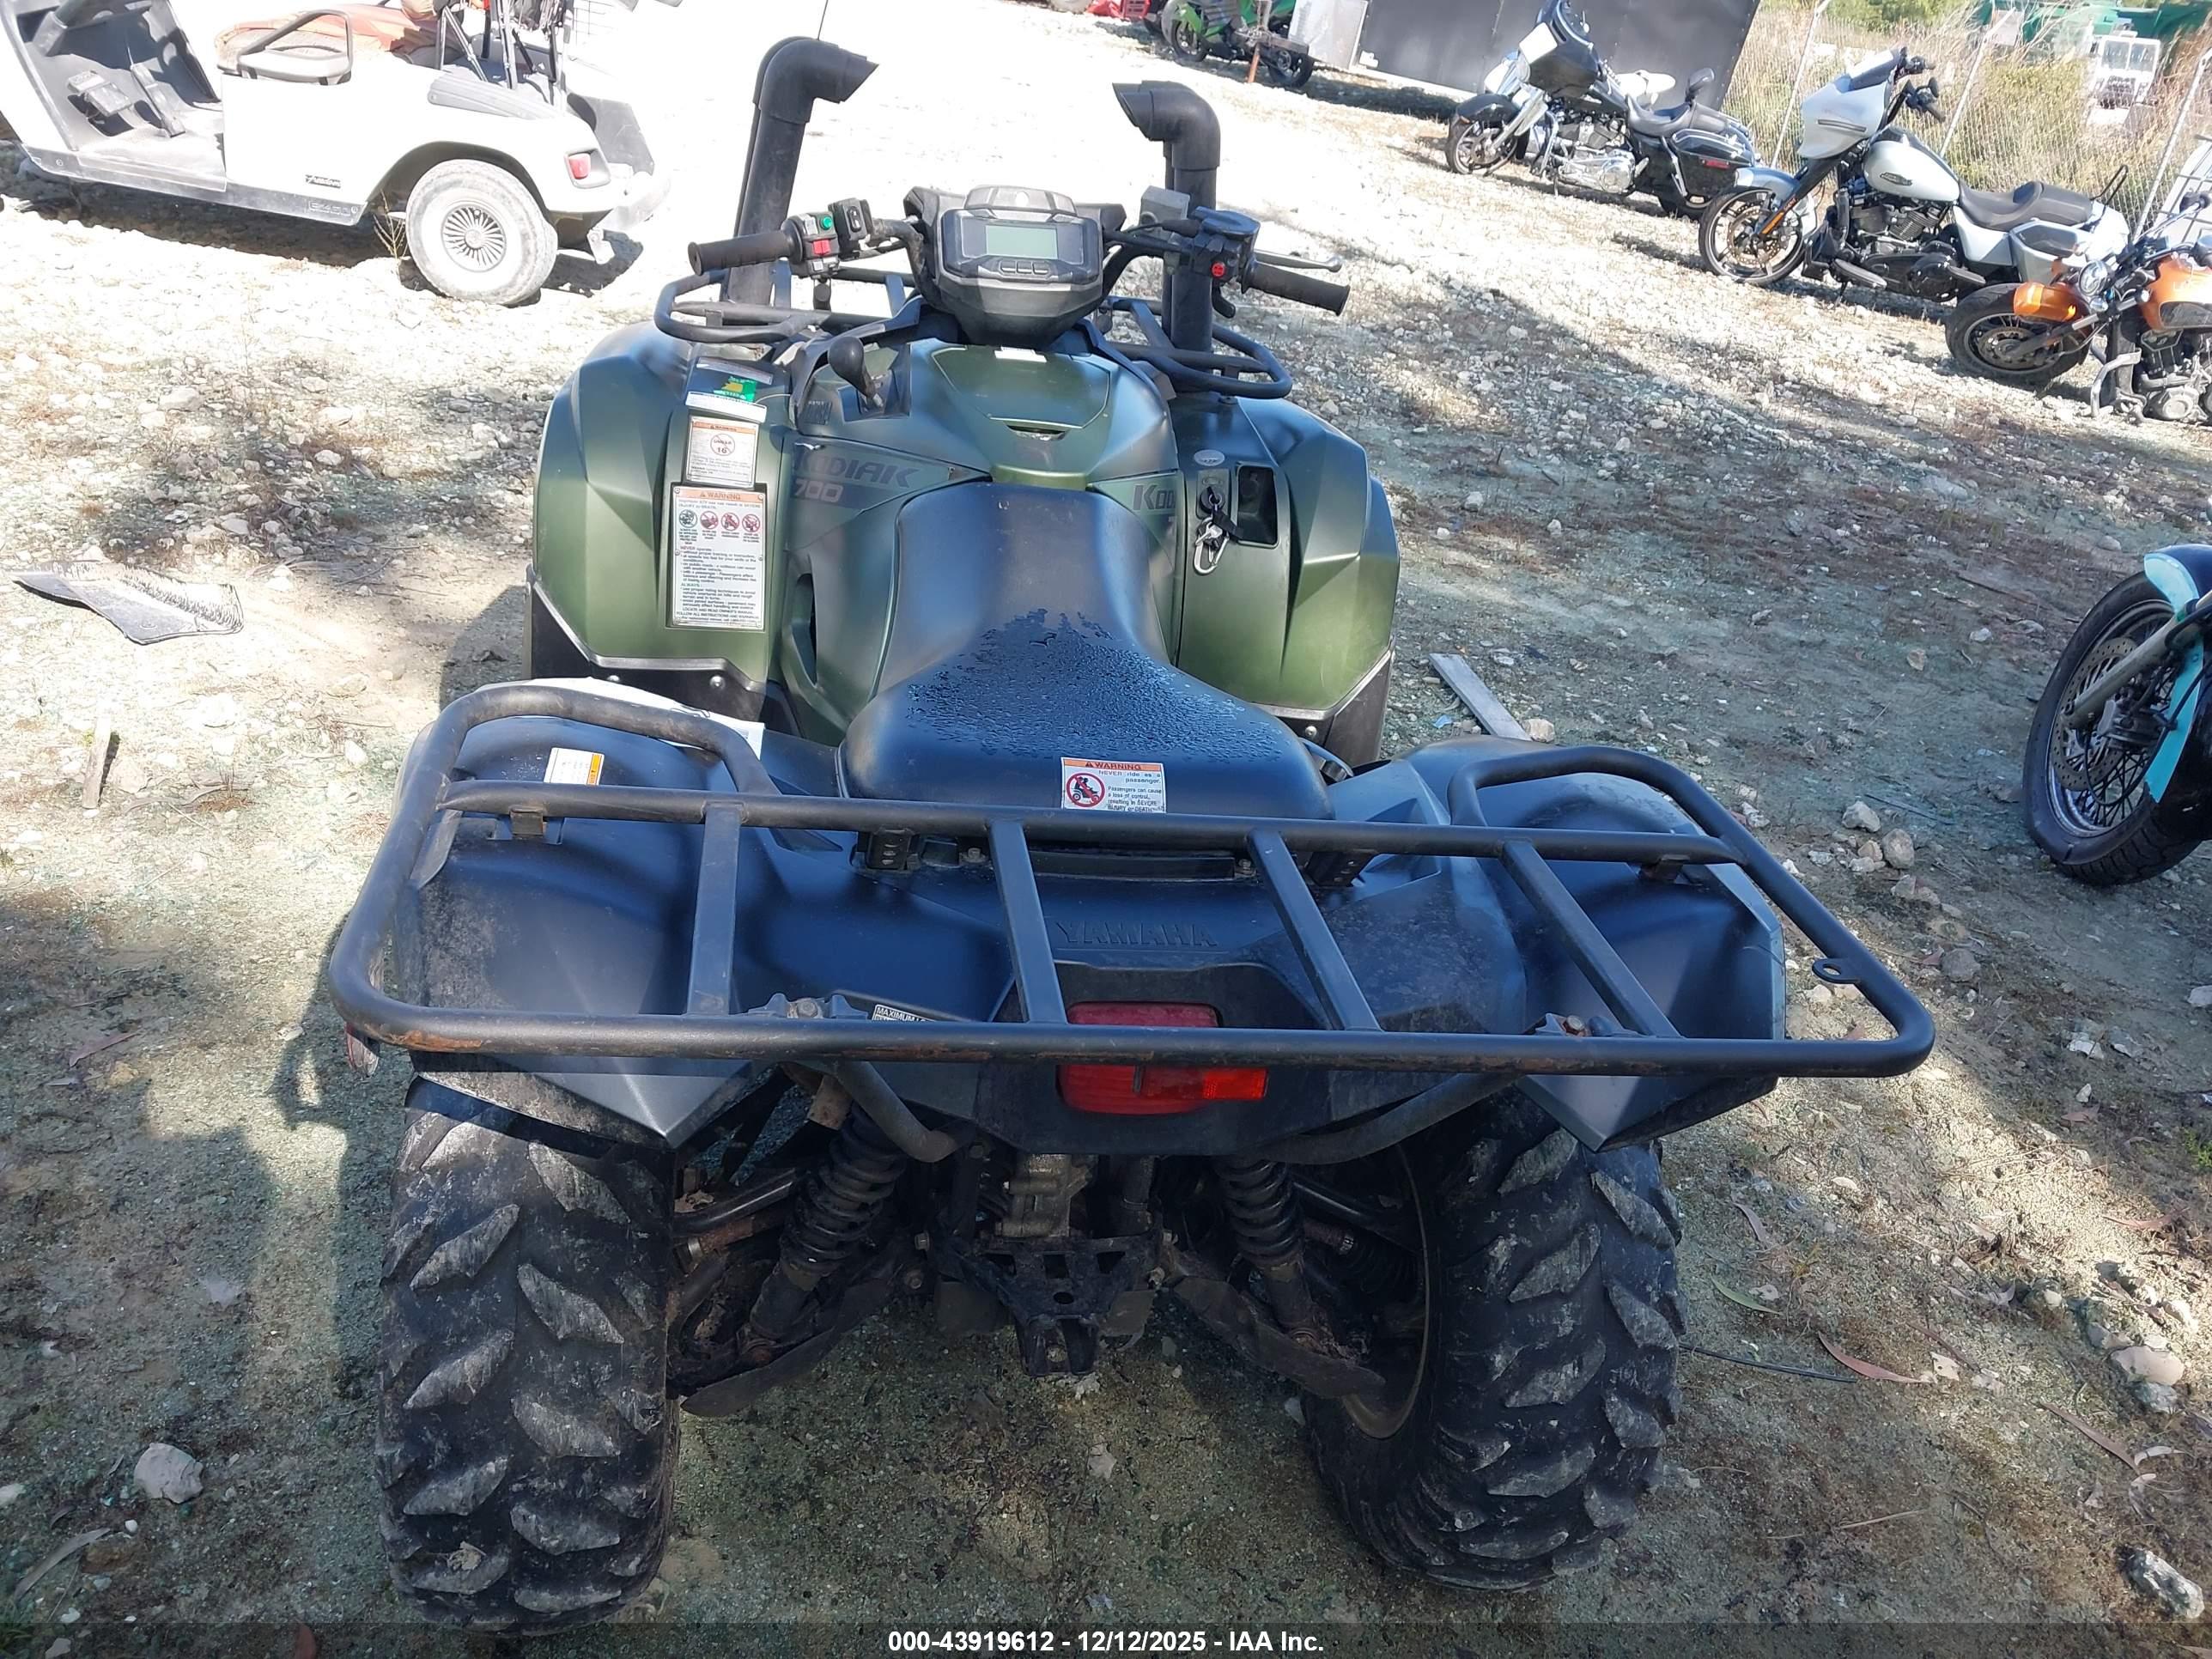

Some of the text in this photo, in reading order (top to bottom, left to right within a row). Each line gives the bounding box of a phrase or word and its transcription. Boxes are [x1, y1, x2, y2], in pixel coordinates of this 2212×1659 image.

[794, 477, 844, 503] 700
[1096, 761, 1141, 771] WARNING
[1055, 921, 1219, 946] YAMAHA
[876, 1007, 915, 1021] MAXIMUM
